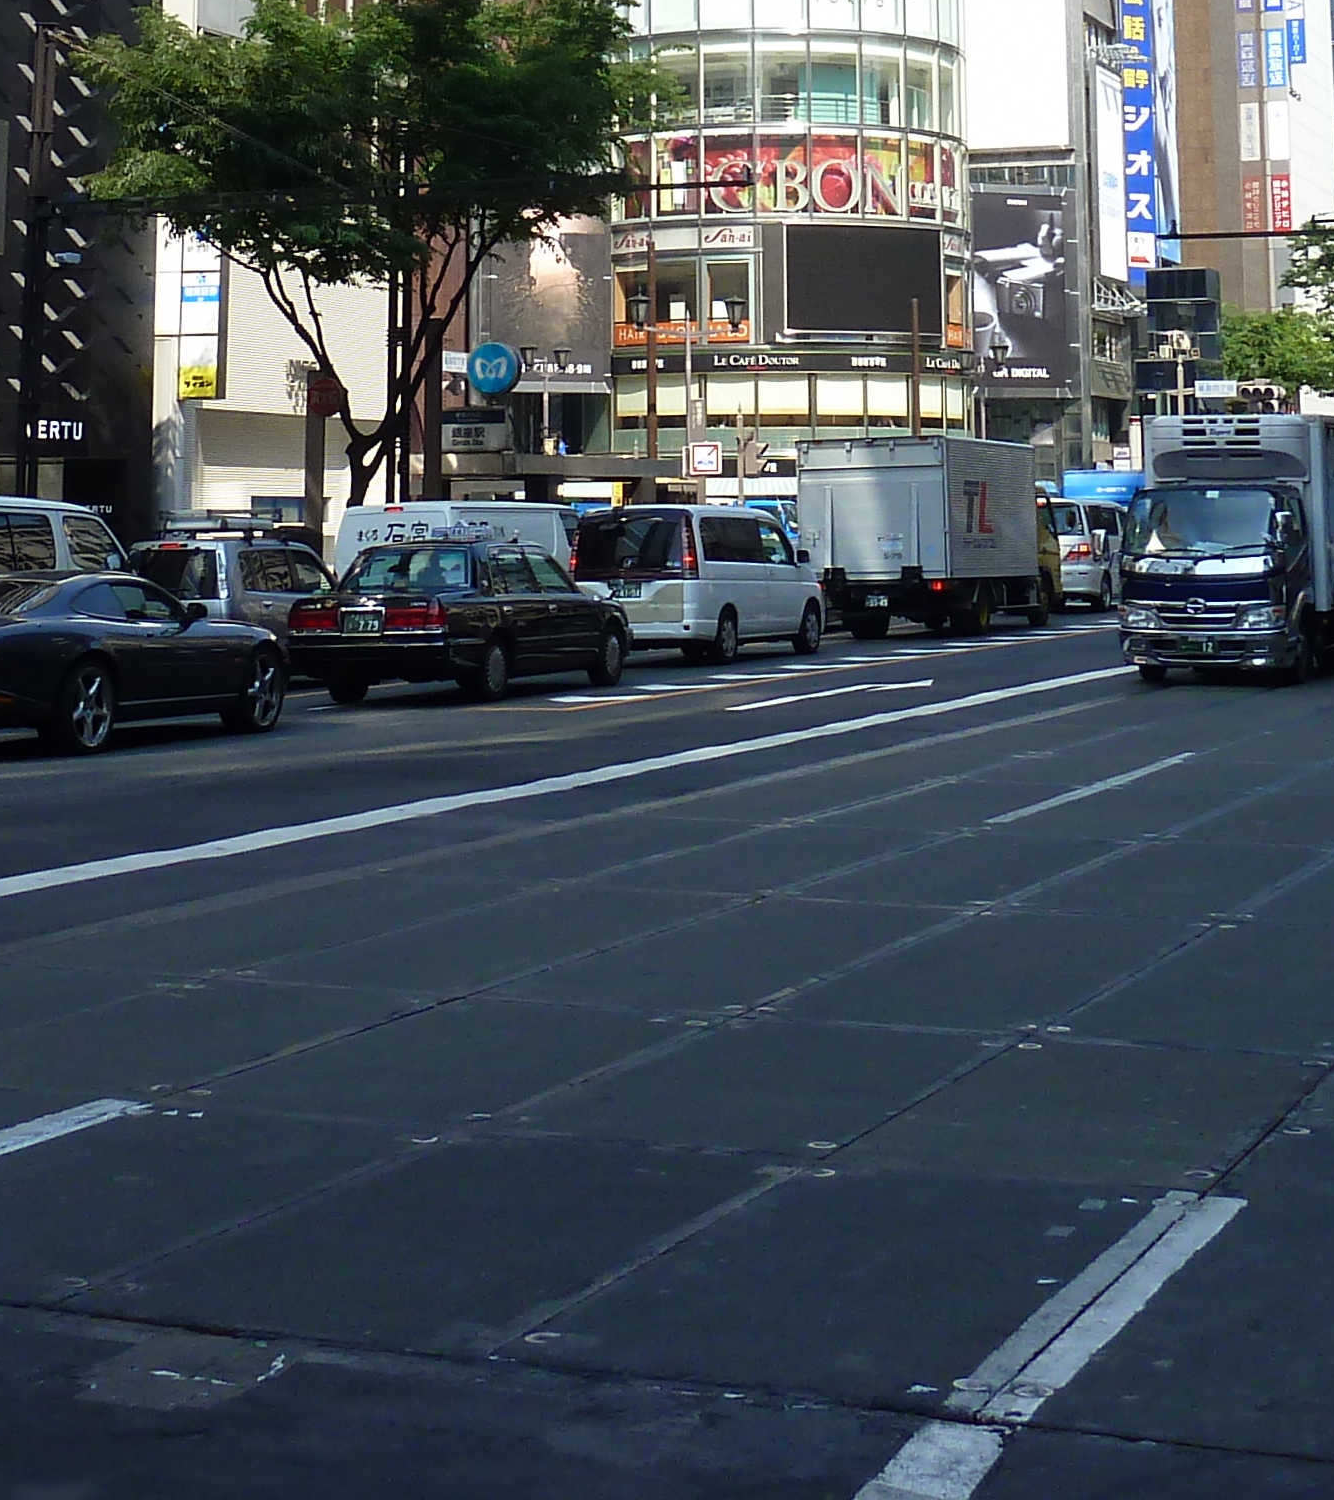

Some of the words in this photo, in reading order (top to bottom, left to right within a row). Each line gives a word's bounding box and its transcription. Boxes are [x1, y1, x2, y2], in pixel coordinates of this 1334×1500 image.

[1123, 105, 1153, 221] ジオス
[704, 227, 752, 244] San-ai
[1010, 367, 1050, 379] DIGITAL
[451, 426, 486, 439] 銀座駅
